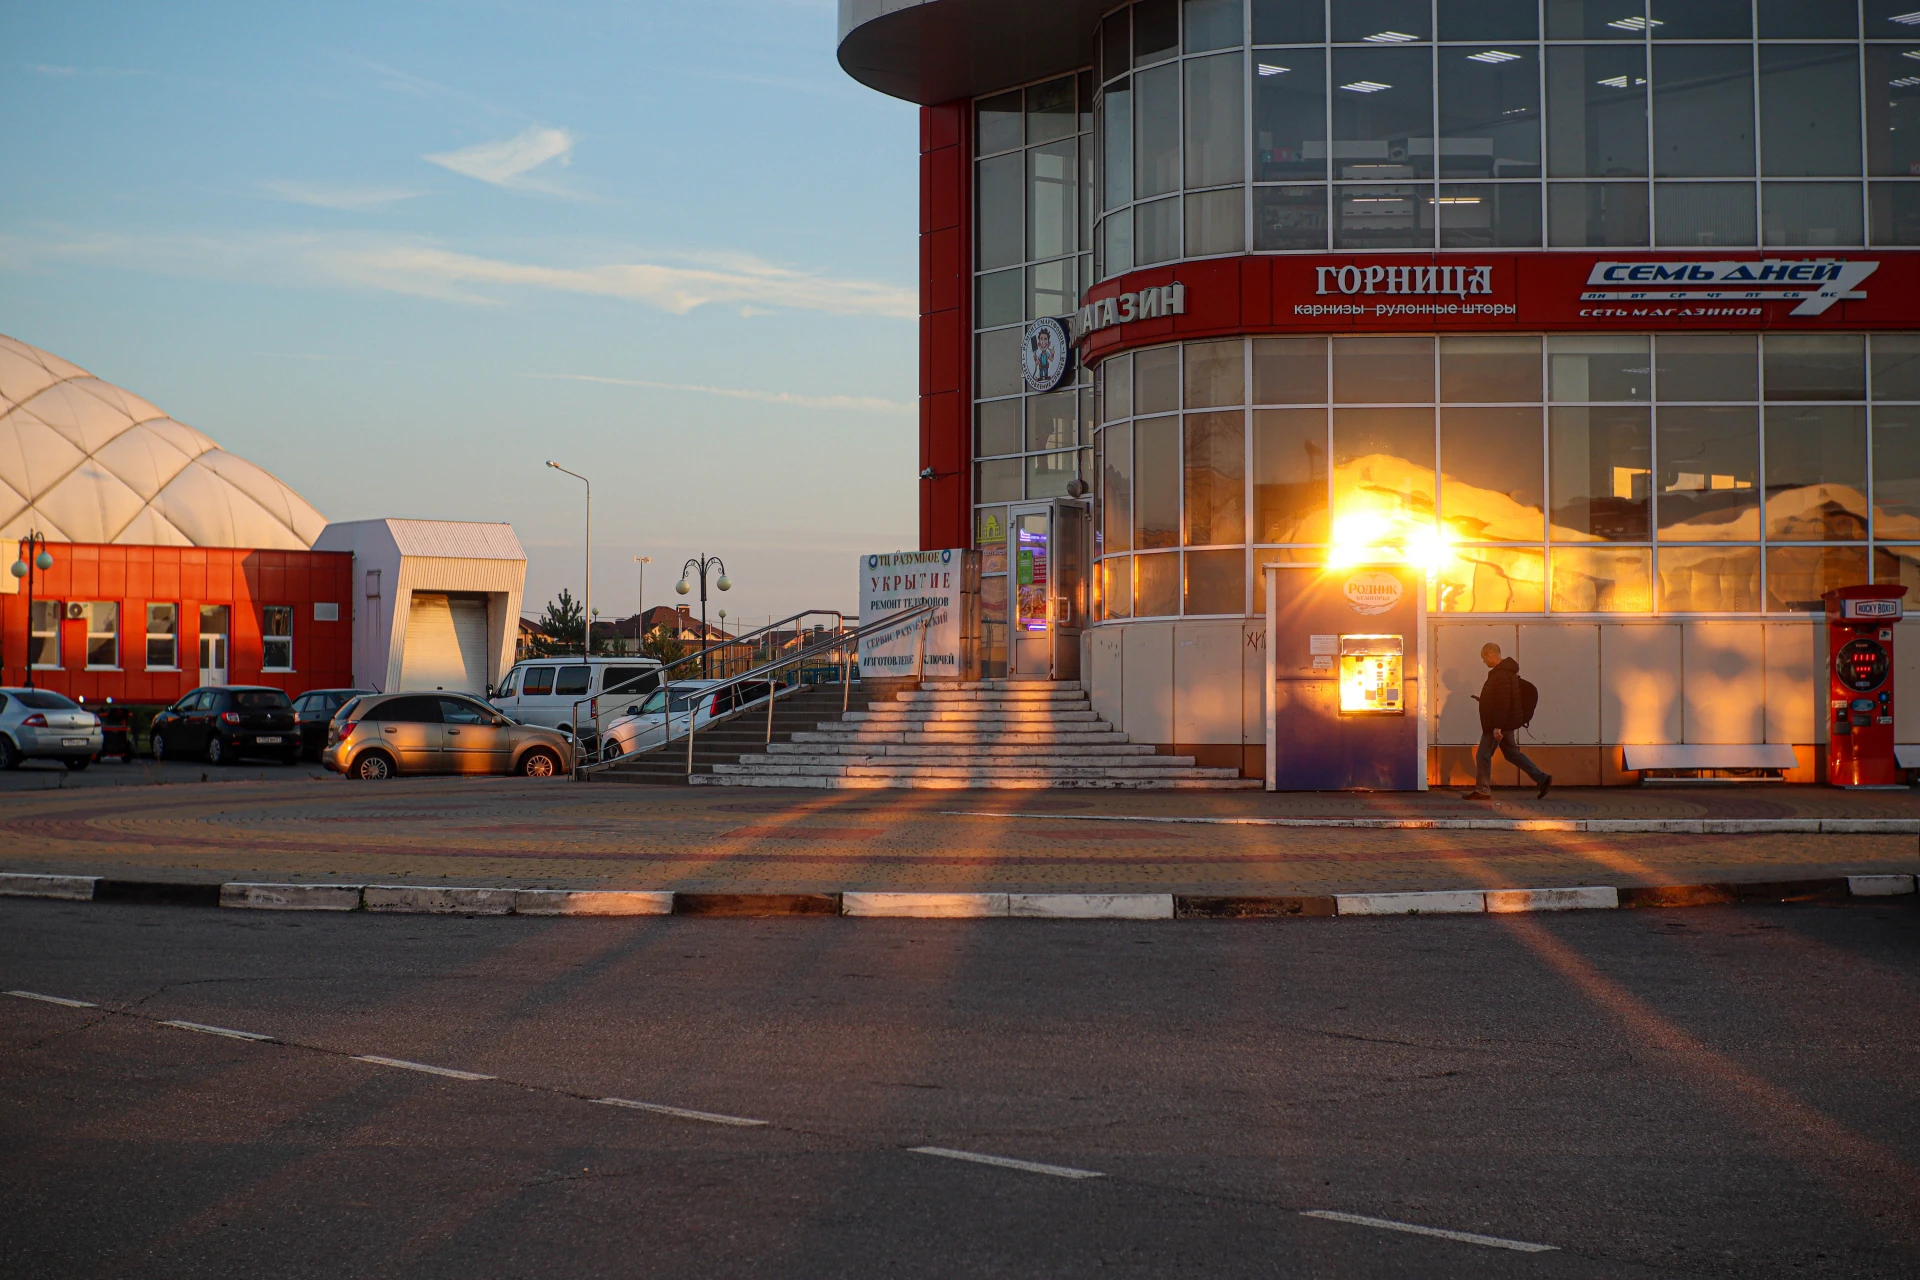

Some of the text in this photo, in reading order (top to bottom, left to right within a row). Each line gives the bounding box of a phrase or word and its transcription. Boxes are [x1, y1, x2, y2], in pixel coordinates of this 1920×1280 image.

[1603, 262, 1844, 281] СЕМЬ ДНЕЙ
[1315, 265, 1493, 300] ГОРНИЦА
[1073, 282, 1185, 341] АГАЗИН
[1294, 304, 1516, 317] карнизы рулонные шторы
[1579, 307, 1763, 317] СЕТЬ МАГАЗИНОВ
[879, 552, 940, 567] ТЦ РАЗУМНОЕ
[871, 572, 951, 593] УКРЫТИЕ
[870, 598, 902, 610] РЕМОНТ
[1858, 603, 1895, 614] ROCKY BOXER
[866, 632, 895, 650] СЕРВИС
